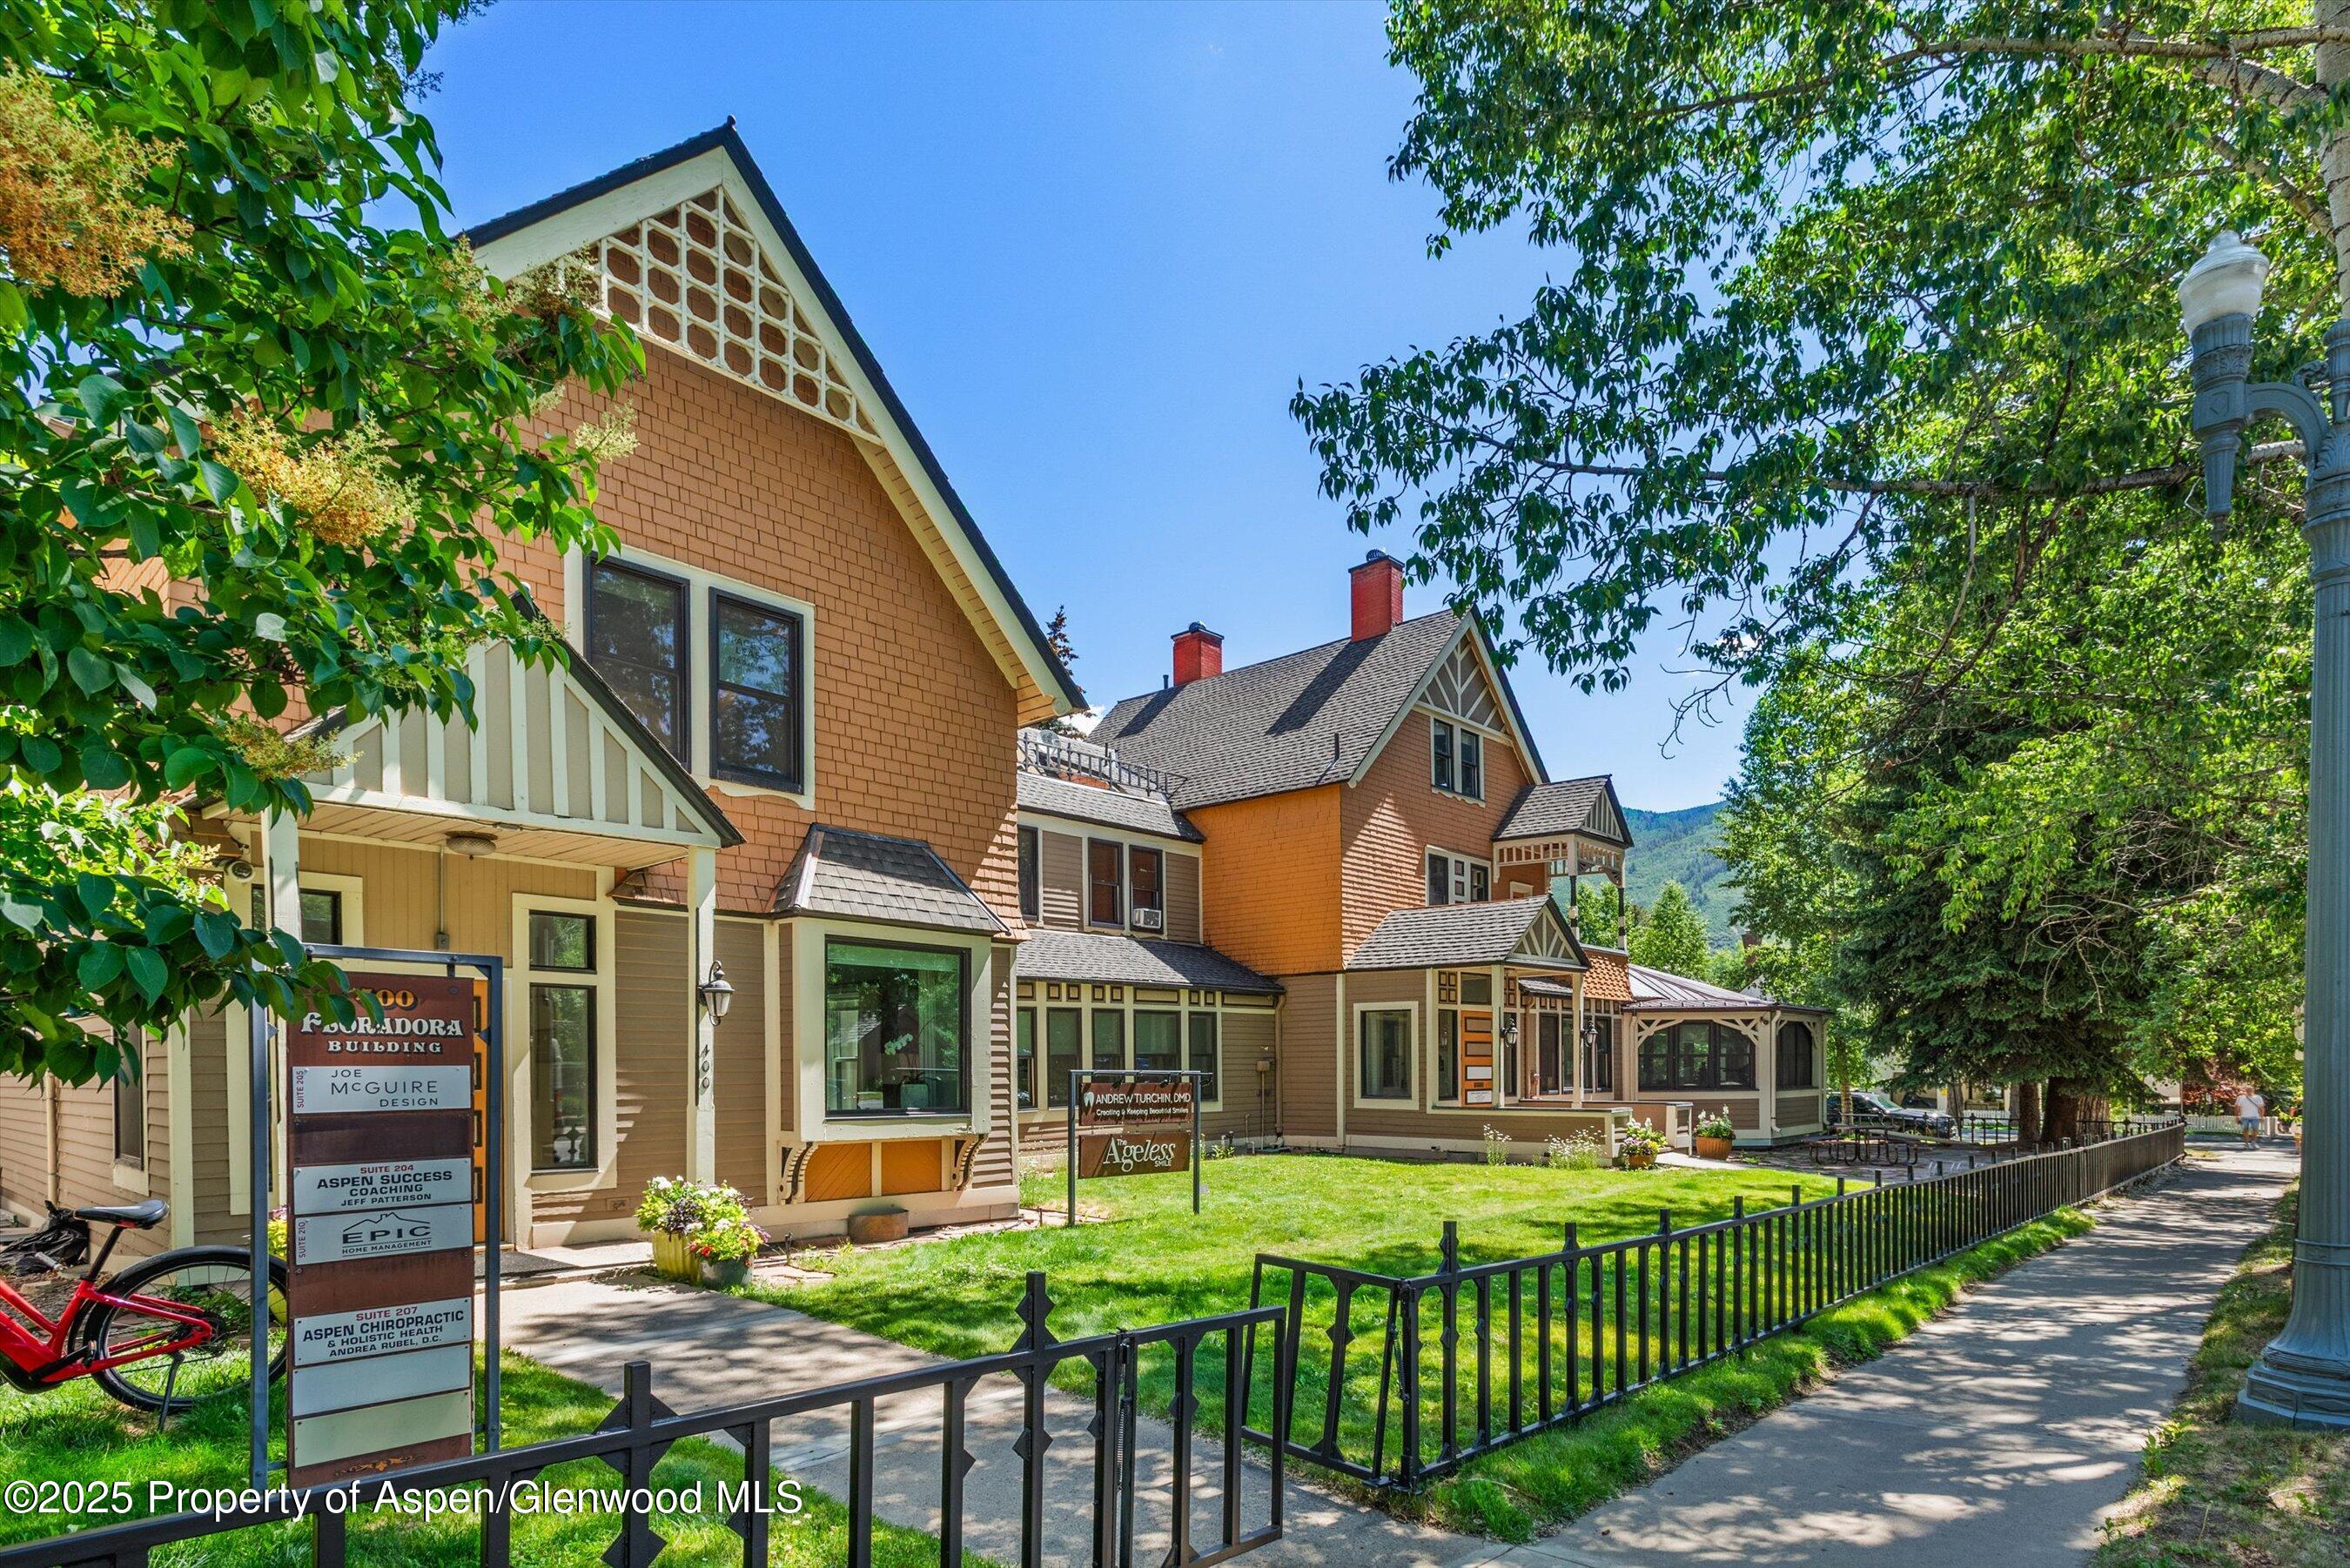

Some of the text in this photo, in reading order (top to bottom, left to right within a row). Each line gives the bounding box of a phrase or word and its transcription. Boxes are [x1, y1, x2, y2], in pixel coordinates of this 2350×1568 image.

[356, 988, 415, 1008] 00
[327, 1041, 442, 1053] BUILDING
[331, 1069, 362, 1078] JOE
[331, 1081, 438, 1095] McGUIRE
[379, 1098, 438, 1108] DESIGN
[1096, 1092, 1191, 1104] ANDREW TURCHIN, DMD
[1097, 1109, 1120, 1117] Creating
[1126, 1108, 1148, 1116] Keeping
[1103, 1136, 1176, 1173] Ageless
[317, 1170, 453, 1189] ASPEN SUCCESS
[350, 1183, 423, 1196] COACHING
[340, 1193, 432, 1207] JEFF PATTERSON
[342, 1226, 431, 1244] EPIC
[342, 1240, 432, 1255] HOME MANAGEMENT
[356, 1306, 418, 1322] SUITE 207
[303, 1310, 465, 1342] ASPEN CHIROPRACTIC
[327, 1324, 443, 1349] & HOLISTIC HEALTH
[329, 1335, 442, 1357] ANDREA RUBEL, D.C.
